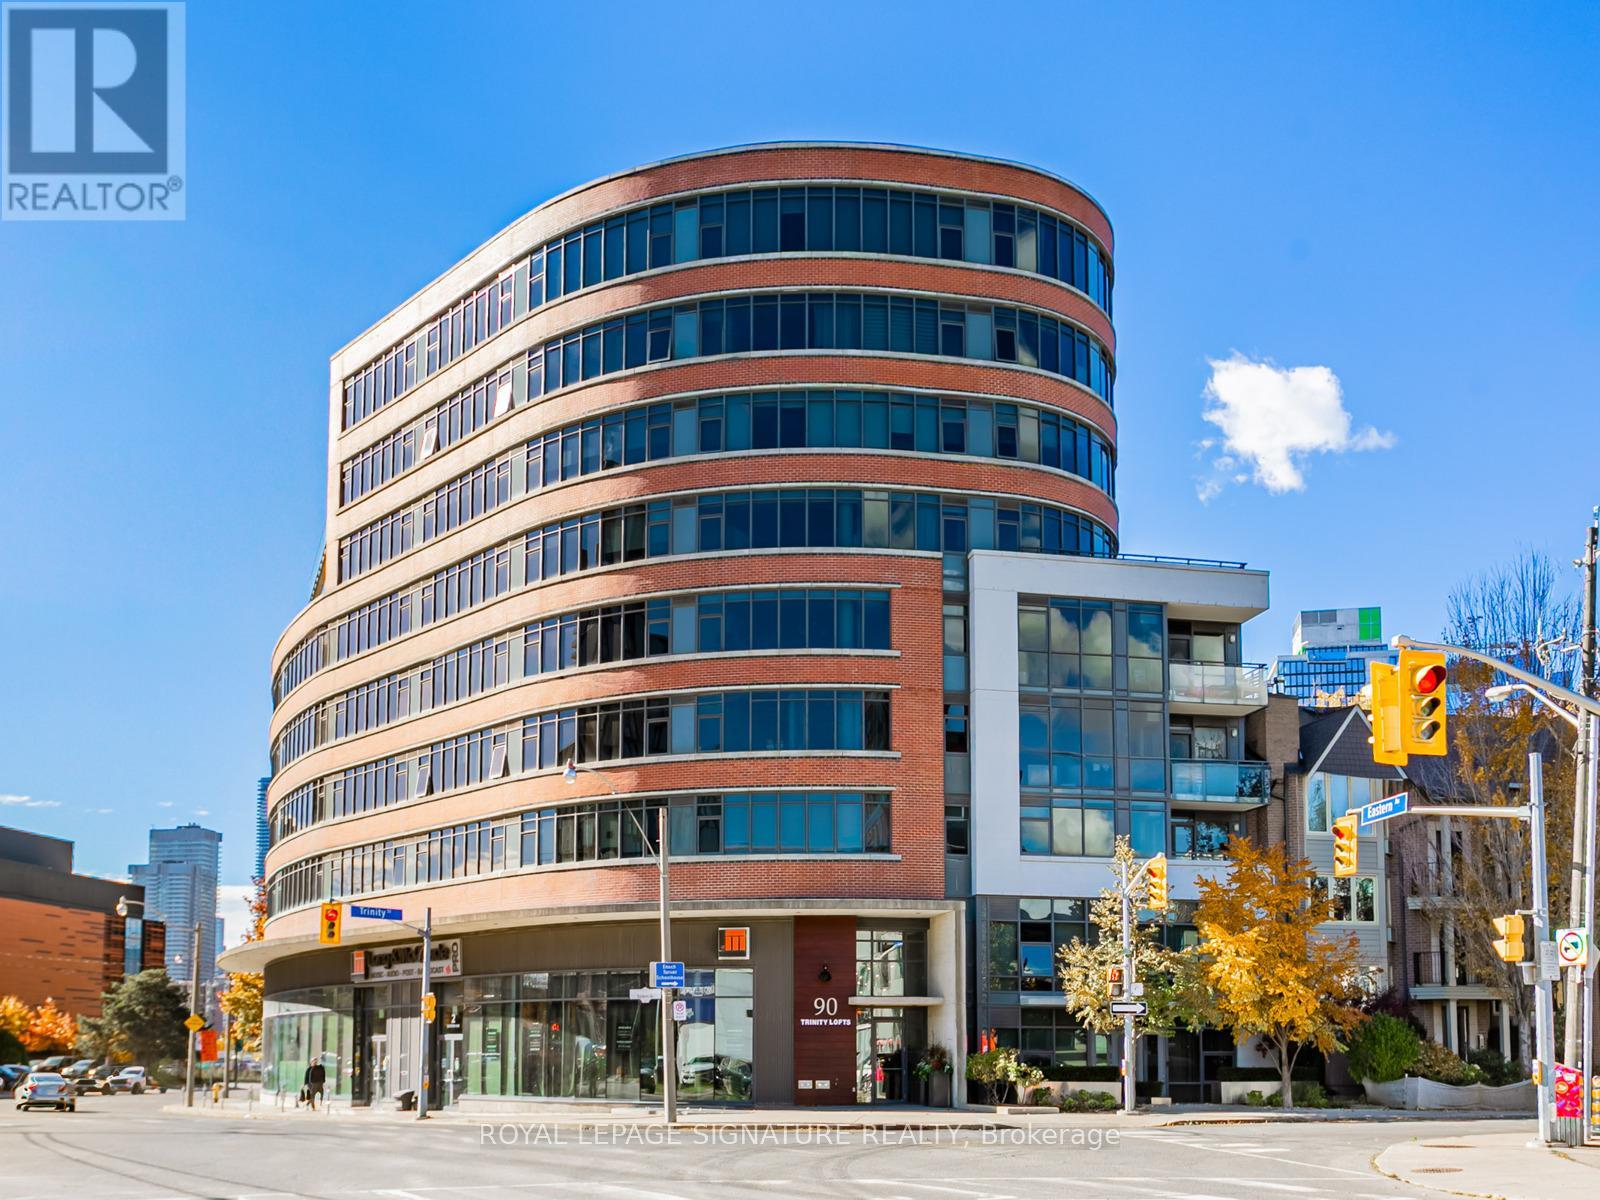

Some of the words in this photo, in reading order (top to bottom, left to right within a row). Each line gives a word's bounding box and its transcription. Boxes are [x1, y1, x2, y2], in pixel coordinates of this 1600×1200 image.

[1367, 802, 1393, 819] Eastern
[360, 907, 386, 919] Trinity
[451, 942, 459, 972] PRO
[813, 997, 838, 1016] 90
[800, 1018, 828, 1026] TRINITY
[829, 1018, 851, 1026] LOFTS
